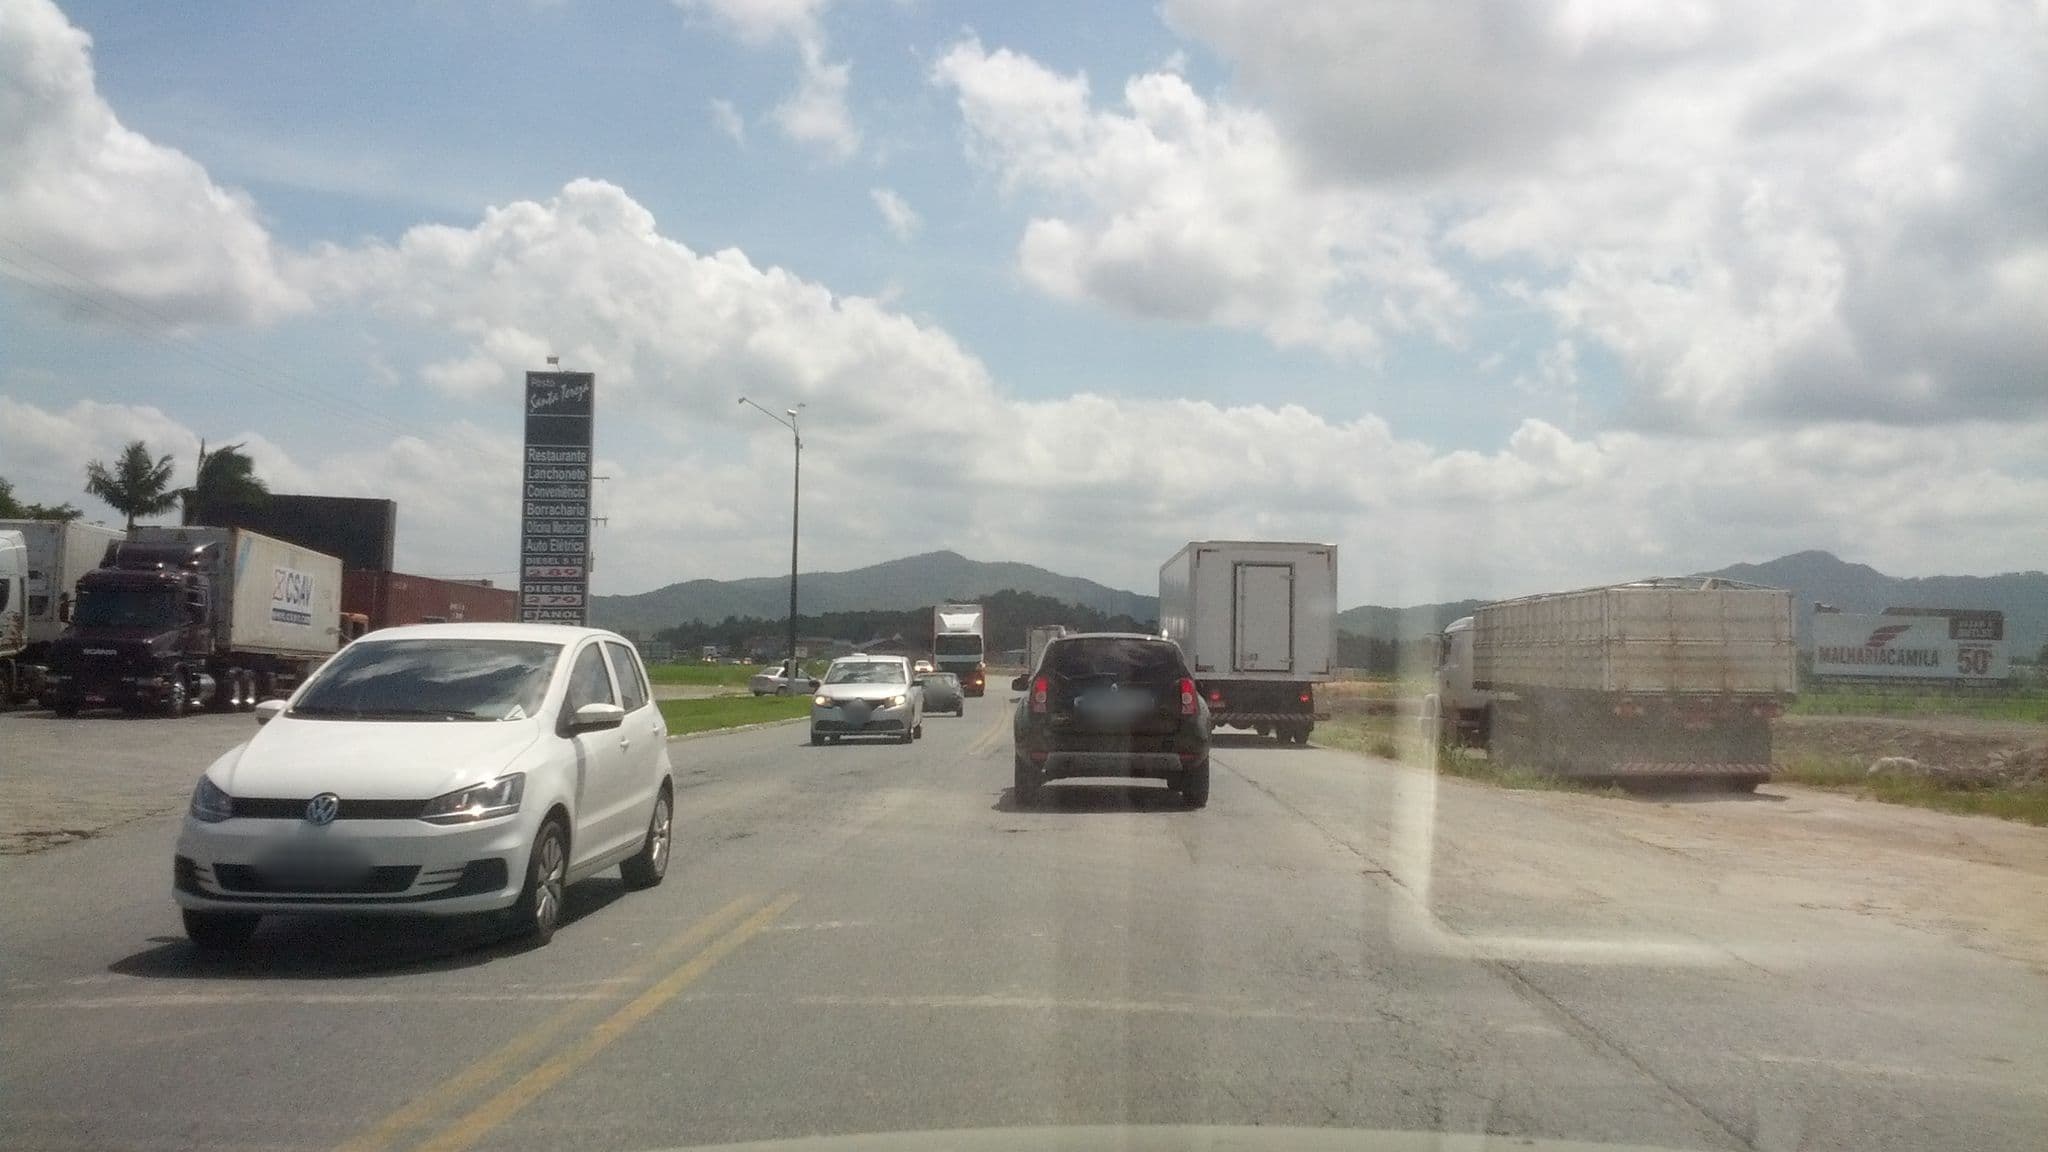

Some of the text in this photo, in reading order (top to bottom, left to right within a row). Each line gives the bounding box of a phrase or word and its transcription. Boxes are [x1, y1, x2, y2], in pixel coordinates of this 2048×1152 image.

[528, 448, 587, 462] Restaurante
[528, 466, 587, 480] Lanchonete
[527, 484, 586, 498] Conveniência
[527, 502, 585, 516] Borracharia
[526, 520, 552, 533] Oficina
[526, 538, 585, 552] Auto Elétrica
[525, 557, 560, 565] DIESEL
[525, 585, 583, 593] DIESEL
[523, 610, 580, 619] ETANOL
[1957, 649, 1991, 674] 50
